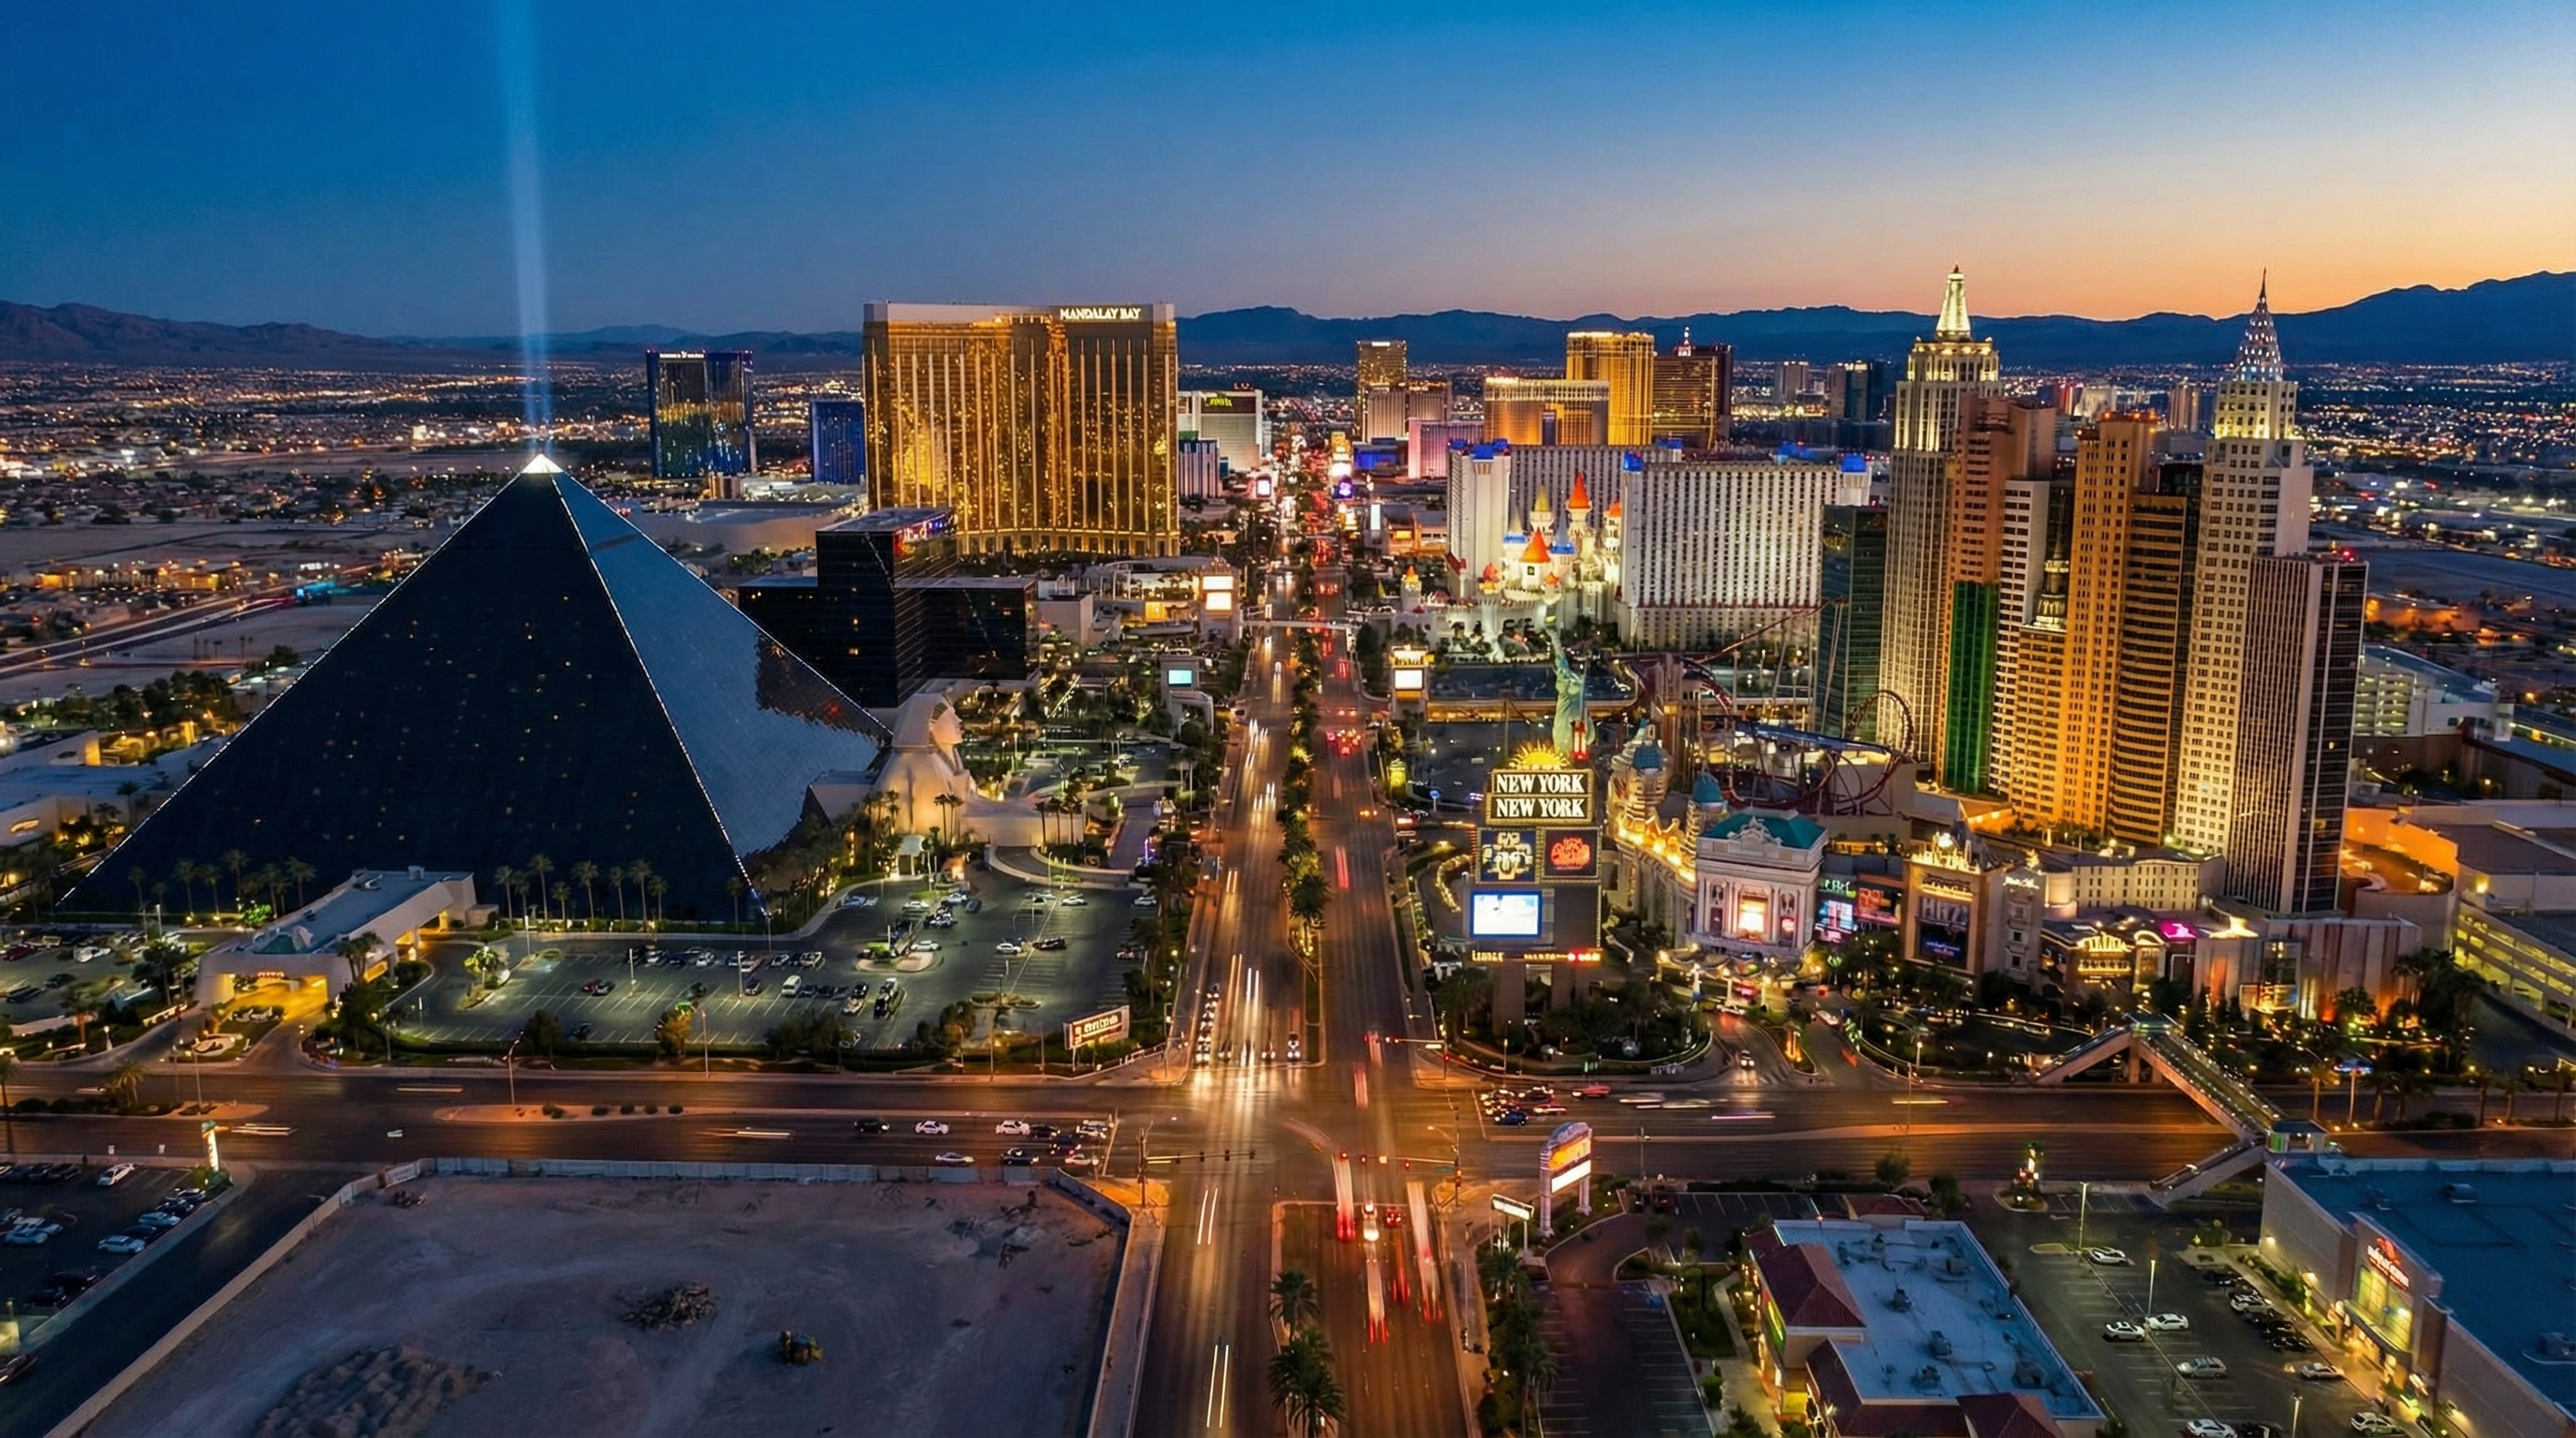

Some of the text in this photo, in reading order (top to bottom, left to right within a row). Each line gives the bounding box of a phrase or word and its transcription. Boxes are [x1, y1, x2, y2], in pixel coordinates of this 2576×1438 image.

[1060, 307, 1119, 320] MANDALAY
[1496, 773, 1585, 793] NEW YORK
[1496, 798, 1585, 817] NEW YORK
